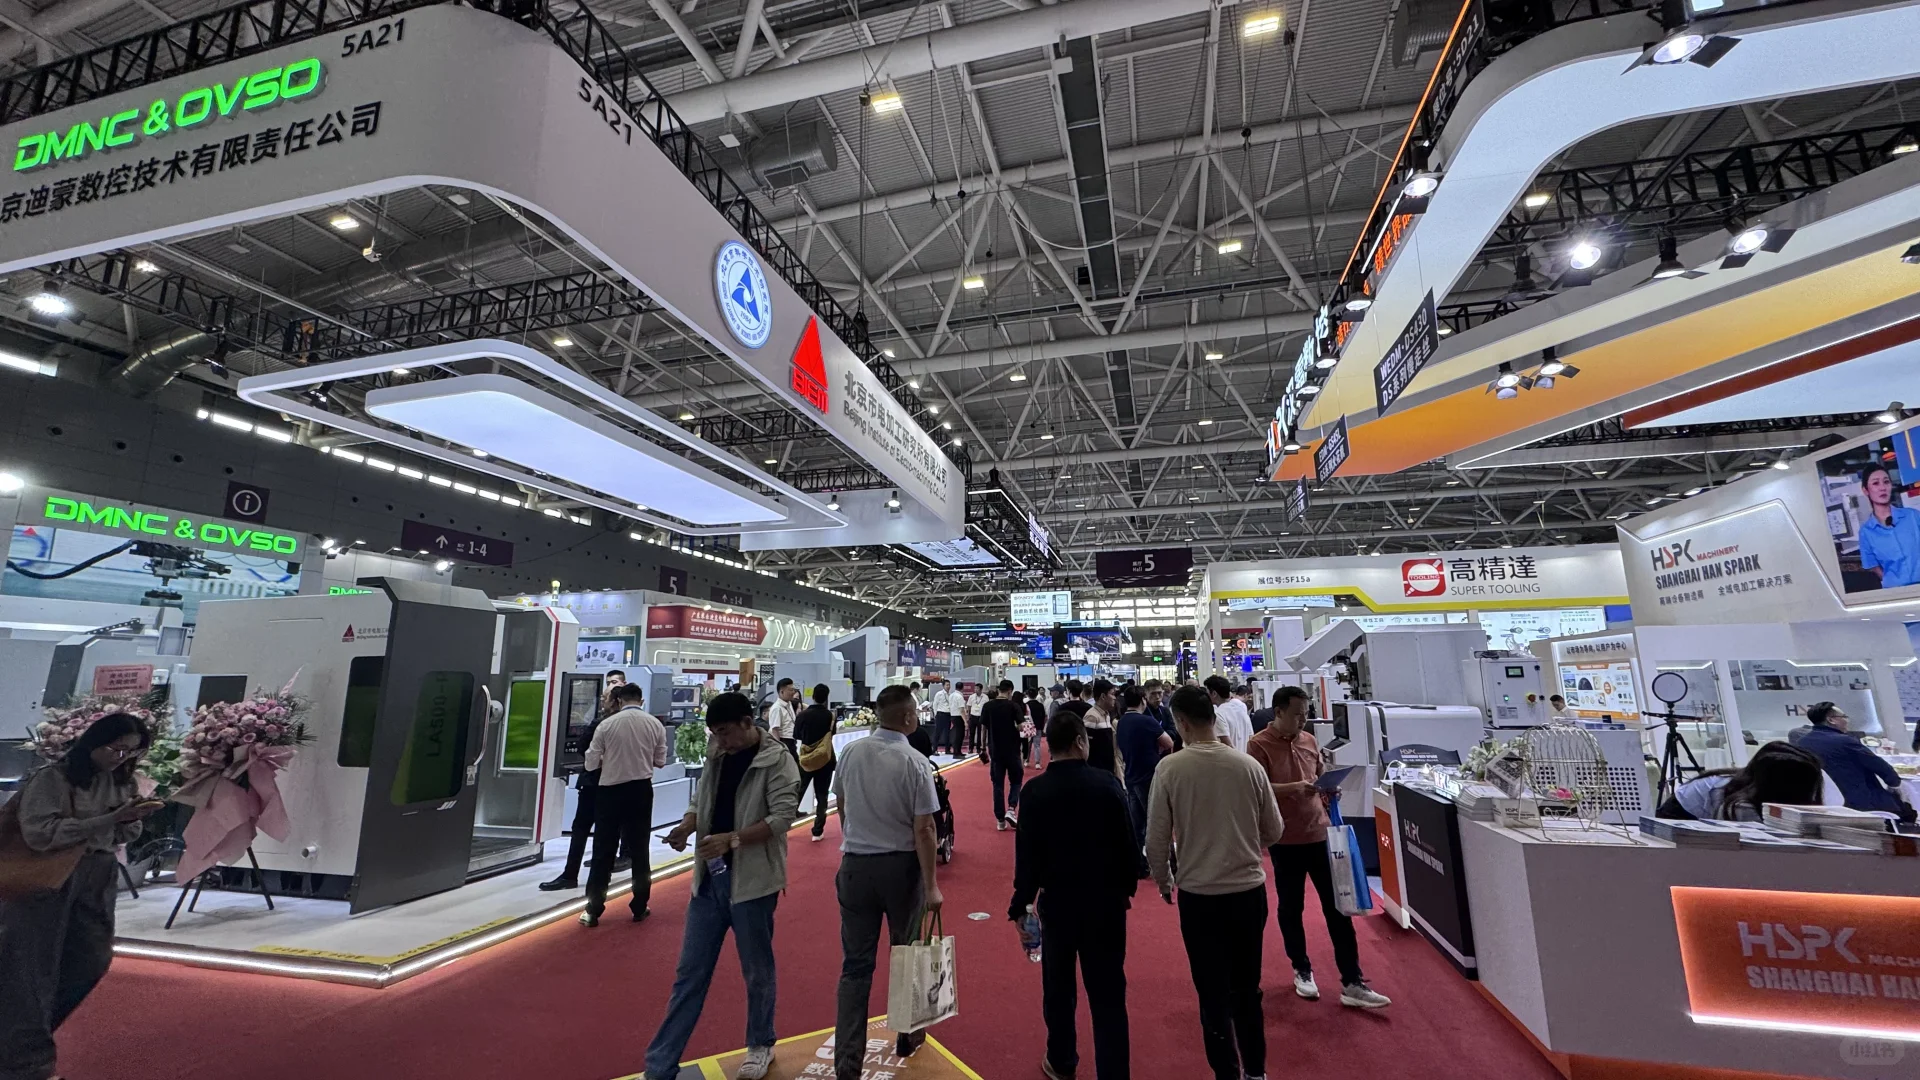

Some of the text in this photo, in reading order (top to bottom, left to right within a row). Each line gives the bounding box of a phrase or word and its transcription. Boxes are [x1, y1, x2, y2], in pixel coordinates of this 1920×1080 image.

[342, 17, 405, 57] 5A21
[14, 58, 321, 171] DMNC & OVSO
[578, 76, 632, 146] 5A21
[1, 101, 382, 224] 京迪蒙数控技术有限责任公司
[792, 366, 829, 415] BIEM
[843, 400, 867, 435] Beijing
[844, 370, 948, 488] 北京市电加工研究所有限公司
[44, 496, 297, 555] DMNC & OVSO
[468, 541, 488, 557] 1-4
[1144, 554, 1155, 572] 5
[1696, 544, 1739, 561] MACHINERY
[669, 576, 677, 594] 5
[1448, 555, 1539, 582] 高精達
[1655, 553, 1762, 590] SHANGHAI HAN SPARK
[1717, 574, 1793, 596] 全域电加工解决方案
[1451, 582, 1541, 596] SUPER TOOLING
[1746, 965, 1877, 998] SHANGHAI
